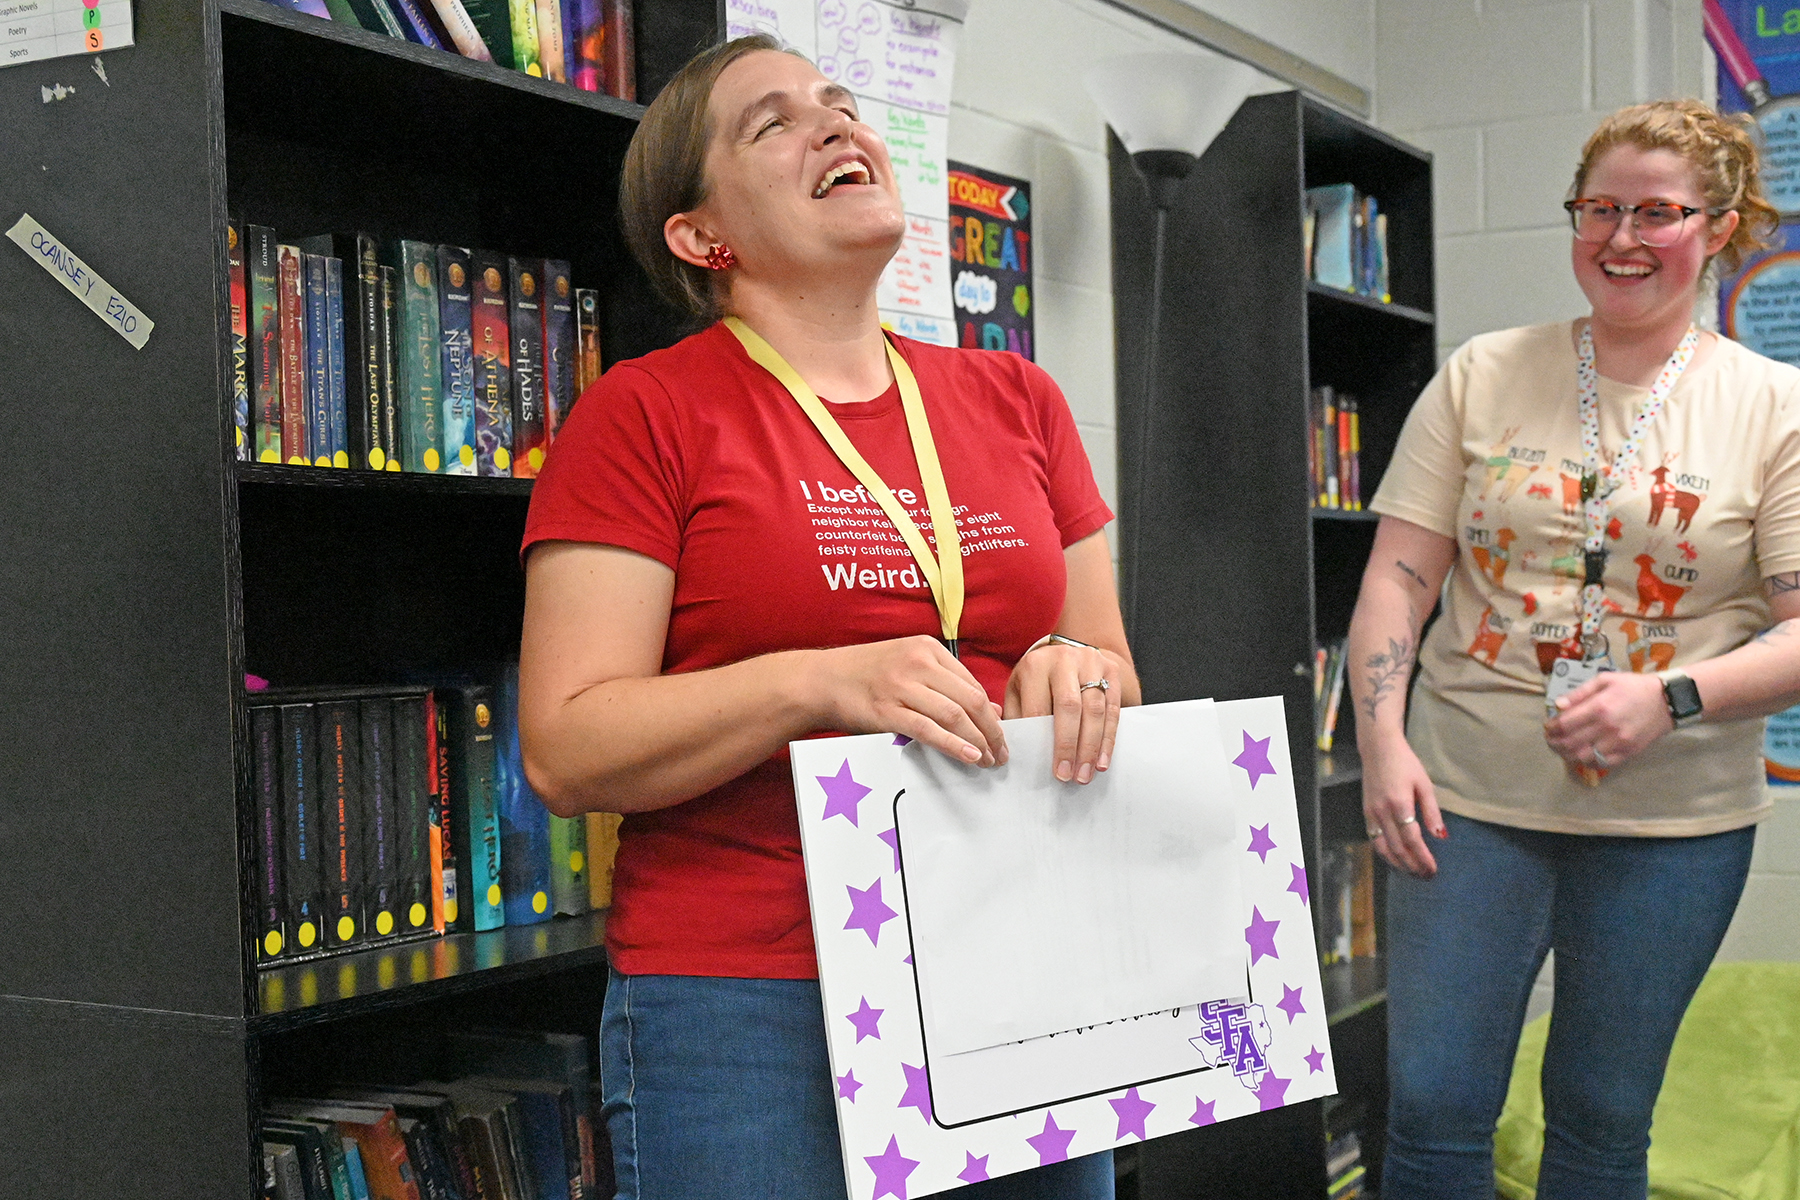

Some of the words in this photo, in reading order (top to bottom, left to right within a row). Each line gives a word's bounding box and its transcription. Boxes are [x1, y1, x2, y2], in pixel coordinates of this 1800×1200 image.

[18, 3, 38, 13] Novels
[89, 10, 95, 24] P
[8, 26, 27, 36] Poetry
[90, 33, 98, 48] S
[9, 48, 29, 59] Sports
[948, 176, 1000, 209] TODAY
[950, 214, 1030, 273] GREAT
[31, 231, 96, 297] OCANSEY
[369, 344, 377, 362] THE
[519, 338, 529, 357] OF
[232, 329, 249, 399] MARK
[443, 330, 464, 421] NEPTUNE
[368, 363, 379, 392] LAST
[481, 349, 500, 426] ATHENA
[516, 358, 533, 422] HADES
[369, 392, 380, 448] OLYMPIAN
[798, 479, 813, 500] I
[816, 480, 918, 505] befe
[806, 503, 853, 516] Except
[920, 504, 969, 518] fogn
[811, 516, 869, 528] neighbor
[871, 518, 897, 529] Kei
[913, 519, 964, 530] eces
[966, 511, 1003, 525] eight
[815, 529, 888, 541] counterfeit
[981, 525, 1016, 536] from
[817, 544, 857, 557] feisty
[860, 544, 913, 557] caffeina
[820, 562, 930, 591] Weird.
[1663, 563, 1700, 583] CUPID
[335, 725, 343, 751] HARRY
[337, 754, 345, 784] POTTER
[439, 746, 451, 806] SAVING
[338, 798, 346, 824] ORDER
[441, 809, 453, 860] LUCAS
[1197, 998, 1268, 1077] SFA
